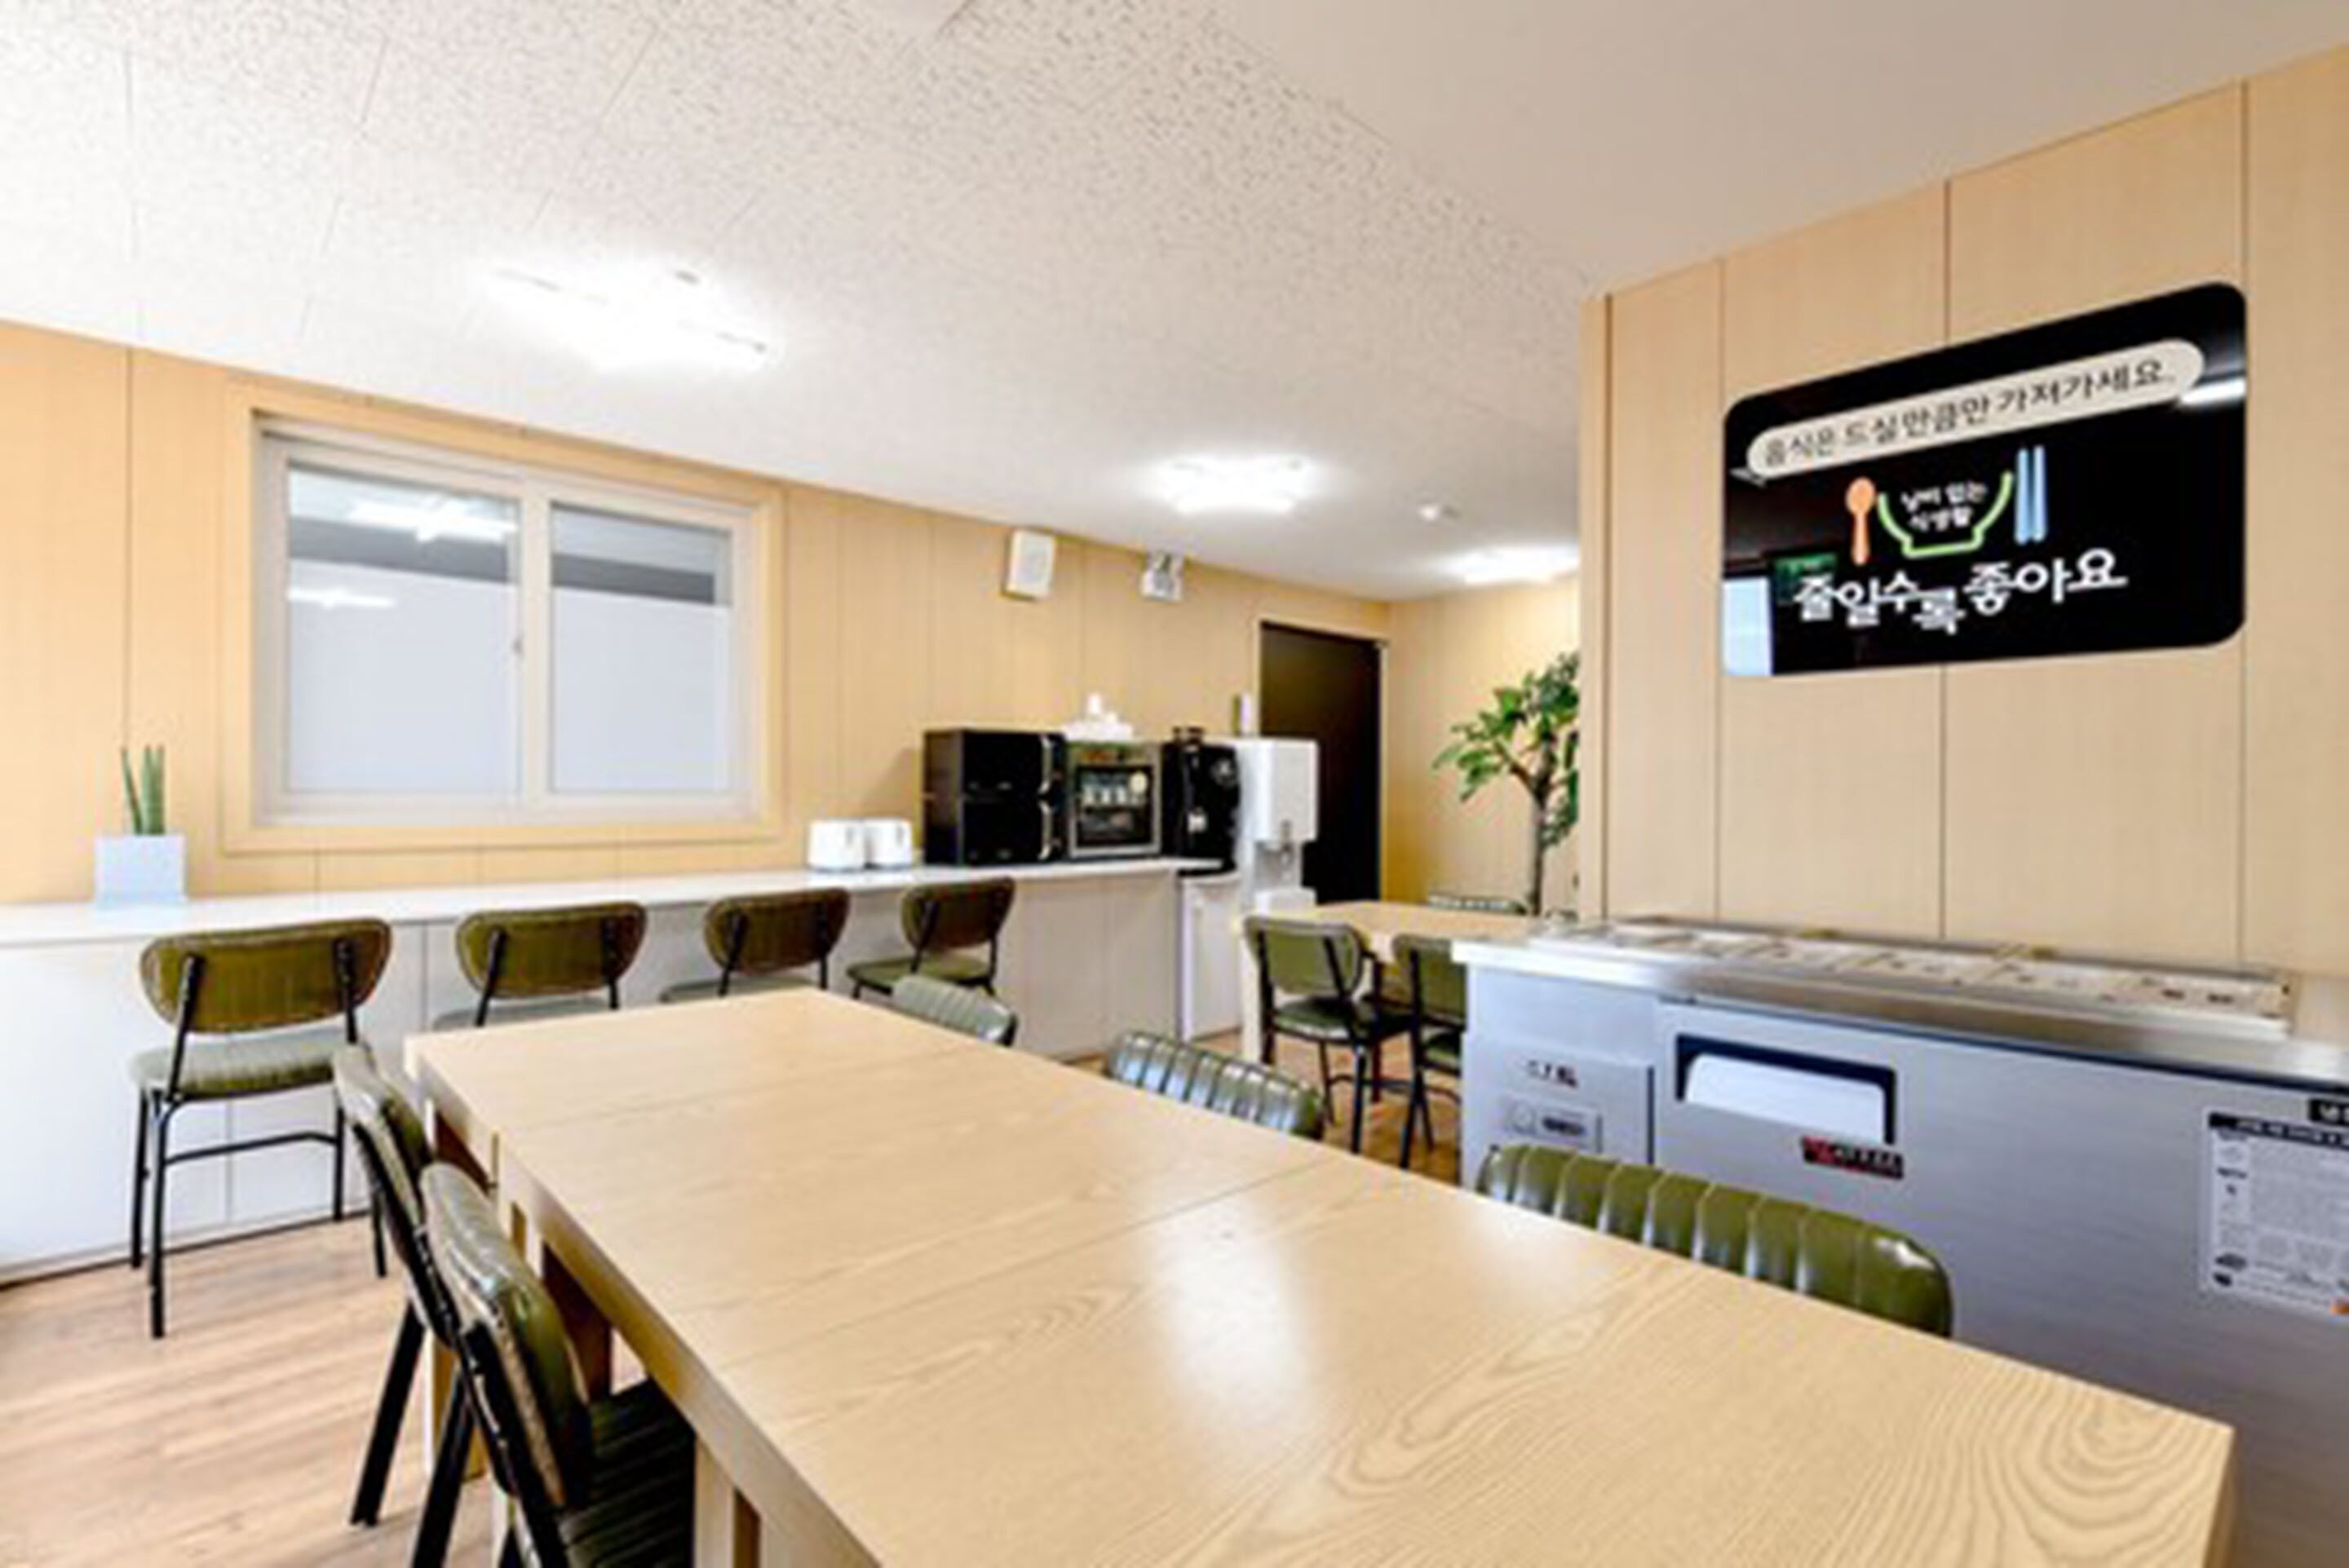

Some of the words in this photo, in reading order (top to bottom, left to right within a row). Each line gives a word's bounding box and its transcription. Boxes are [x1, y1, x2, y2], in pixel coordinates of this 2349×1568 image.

[1764, 426, 1835, 468] 음식은
[1794, 569, 1964, 635] 줄일수록
[1962, 547, 2128, 616] 좋아요
